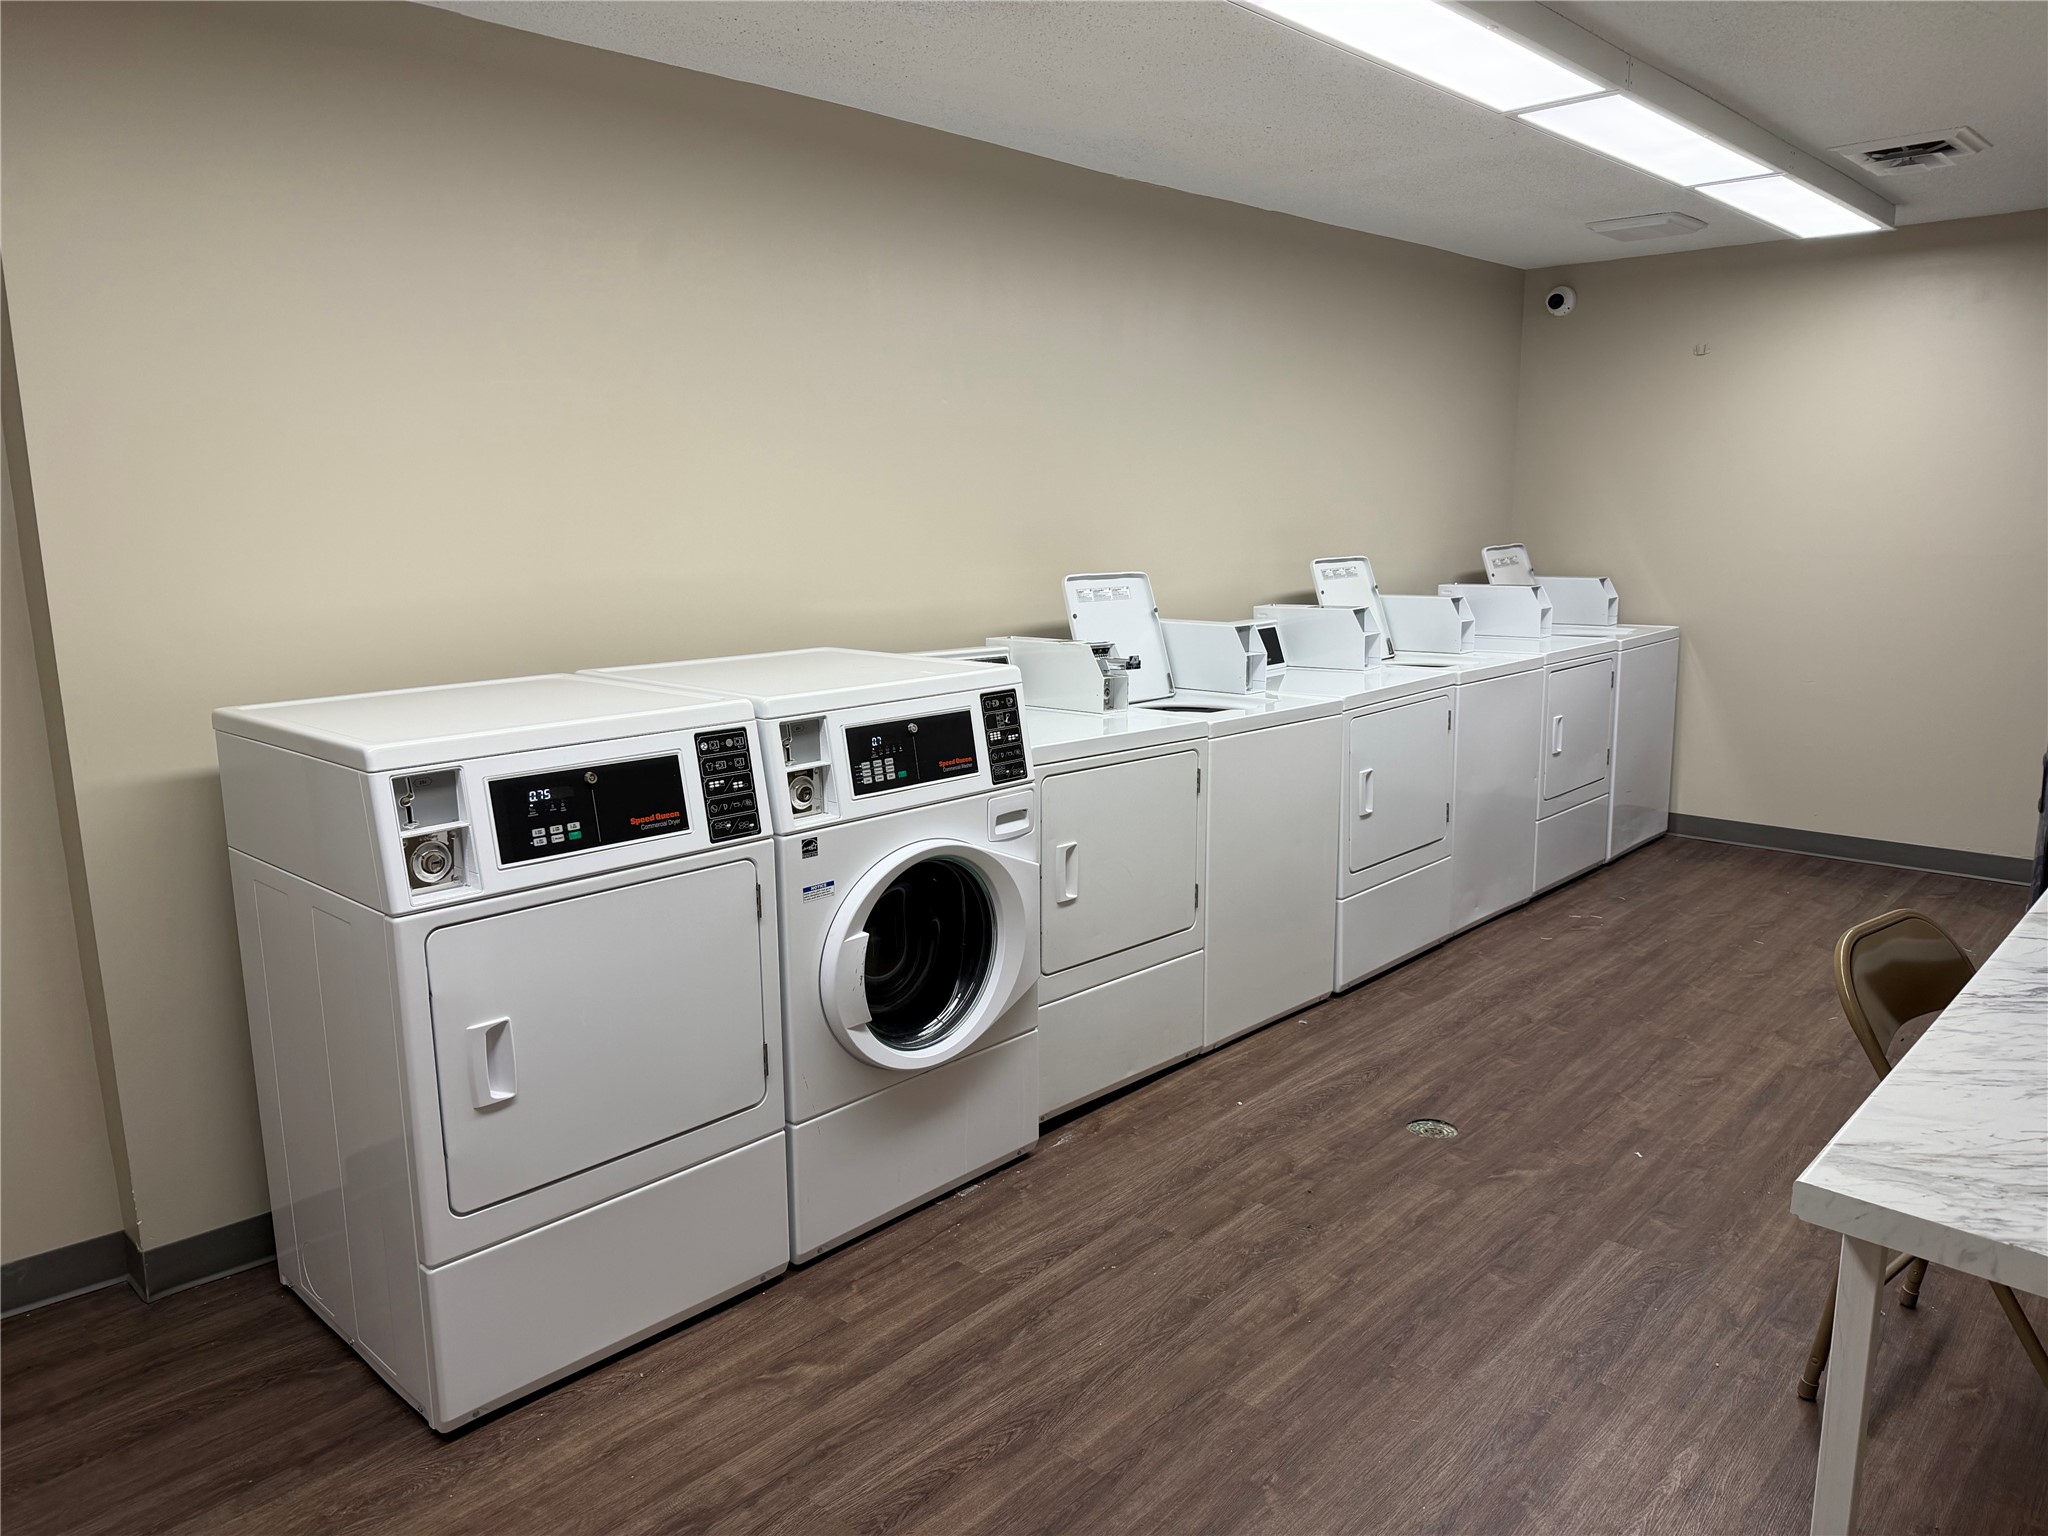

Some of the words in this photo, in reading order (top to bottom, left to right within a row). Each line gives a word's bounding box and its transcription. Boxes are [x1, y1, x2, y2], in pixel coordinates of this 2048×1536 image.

[938, 758, 955, 767] Speed
[955, 756, 973, 764] Queen
[942, 765, 961, 773] Commercial
[630, 814, 655, 825] Speed
[655, 811, 680, 820] Queen
[640, 820, 668, 831] Commercial
[810, 883, 827, 891] NOTICE
